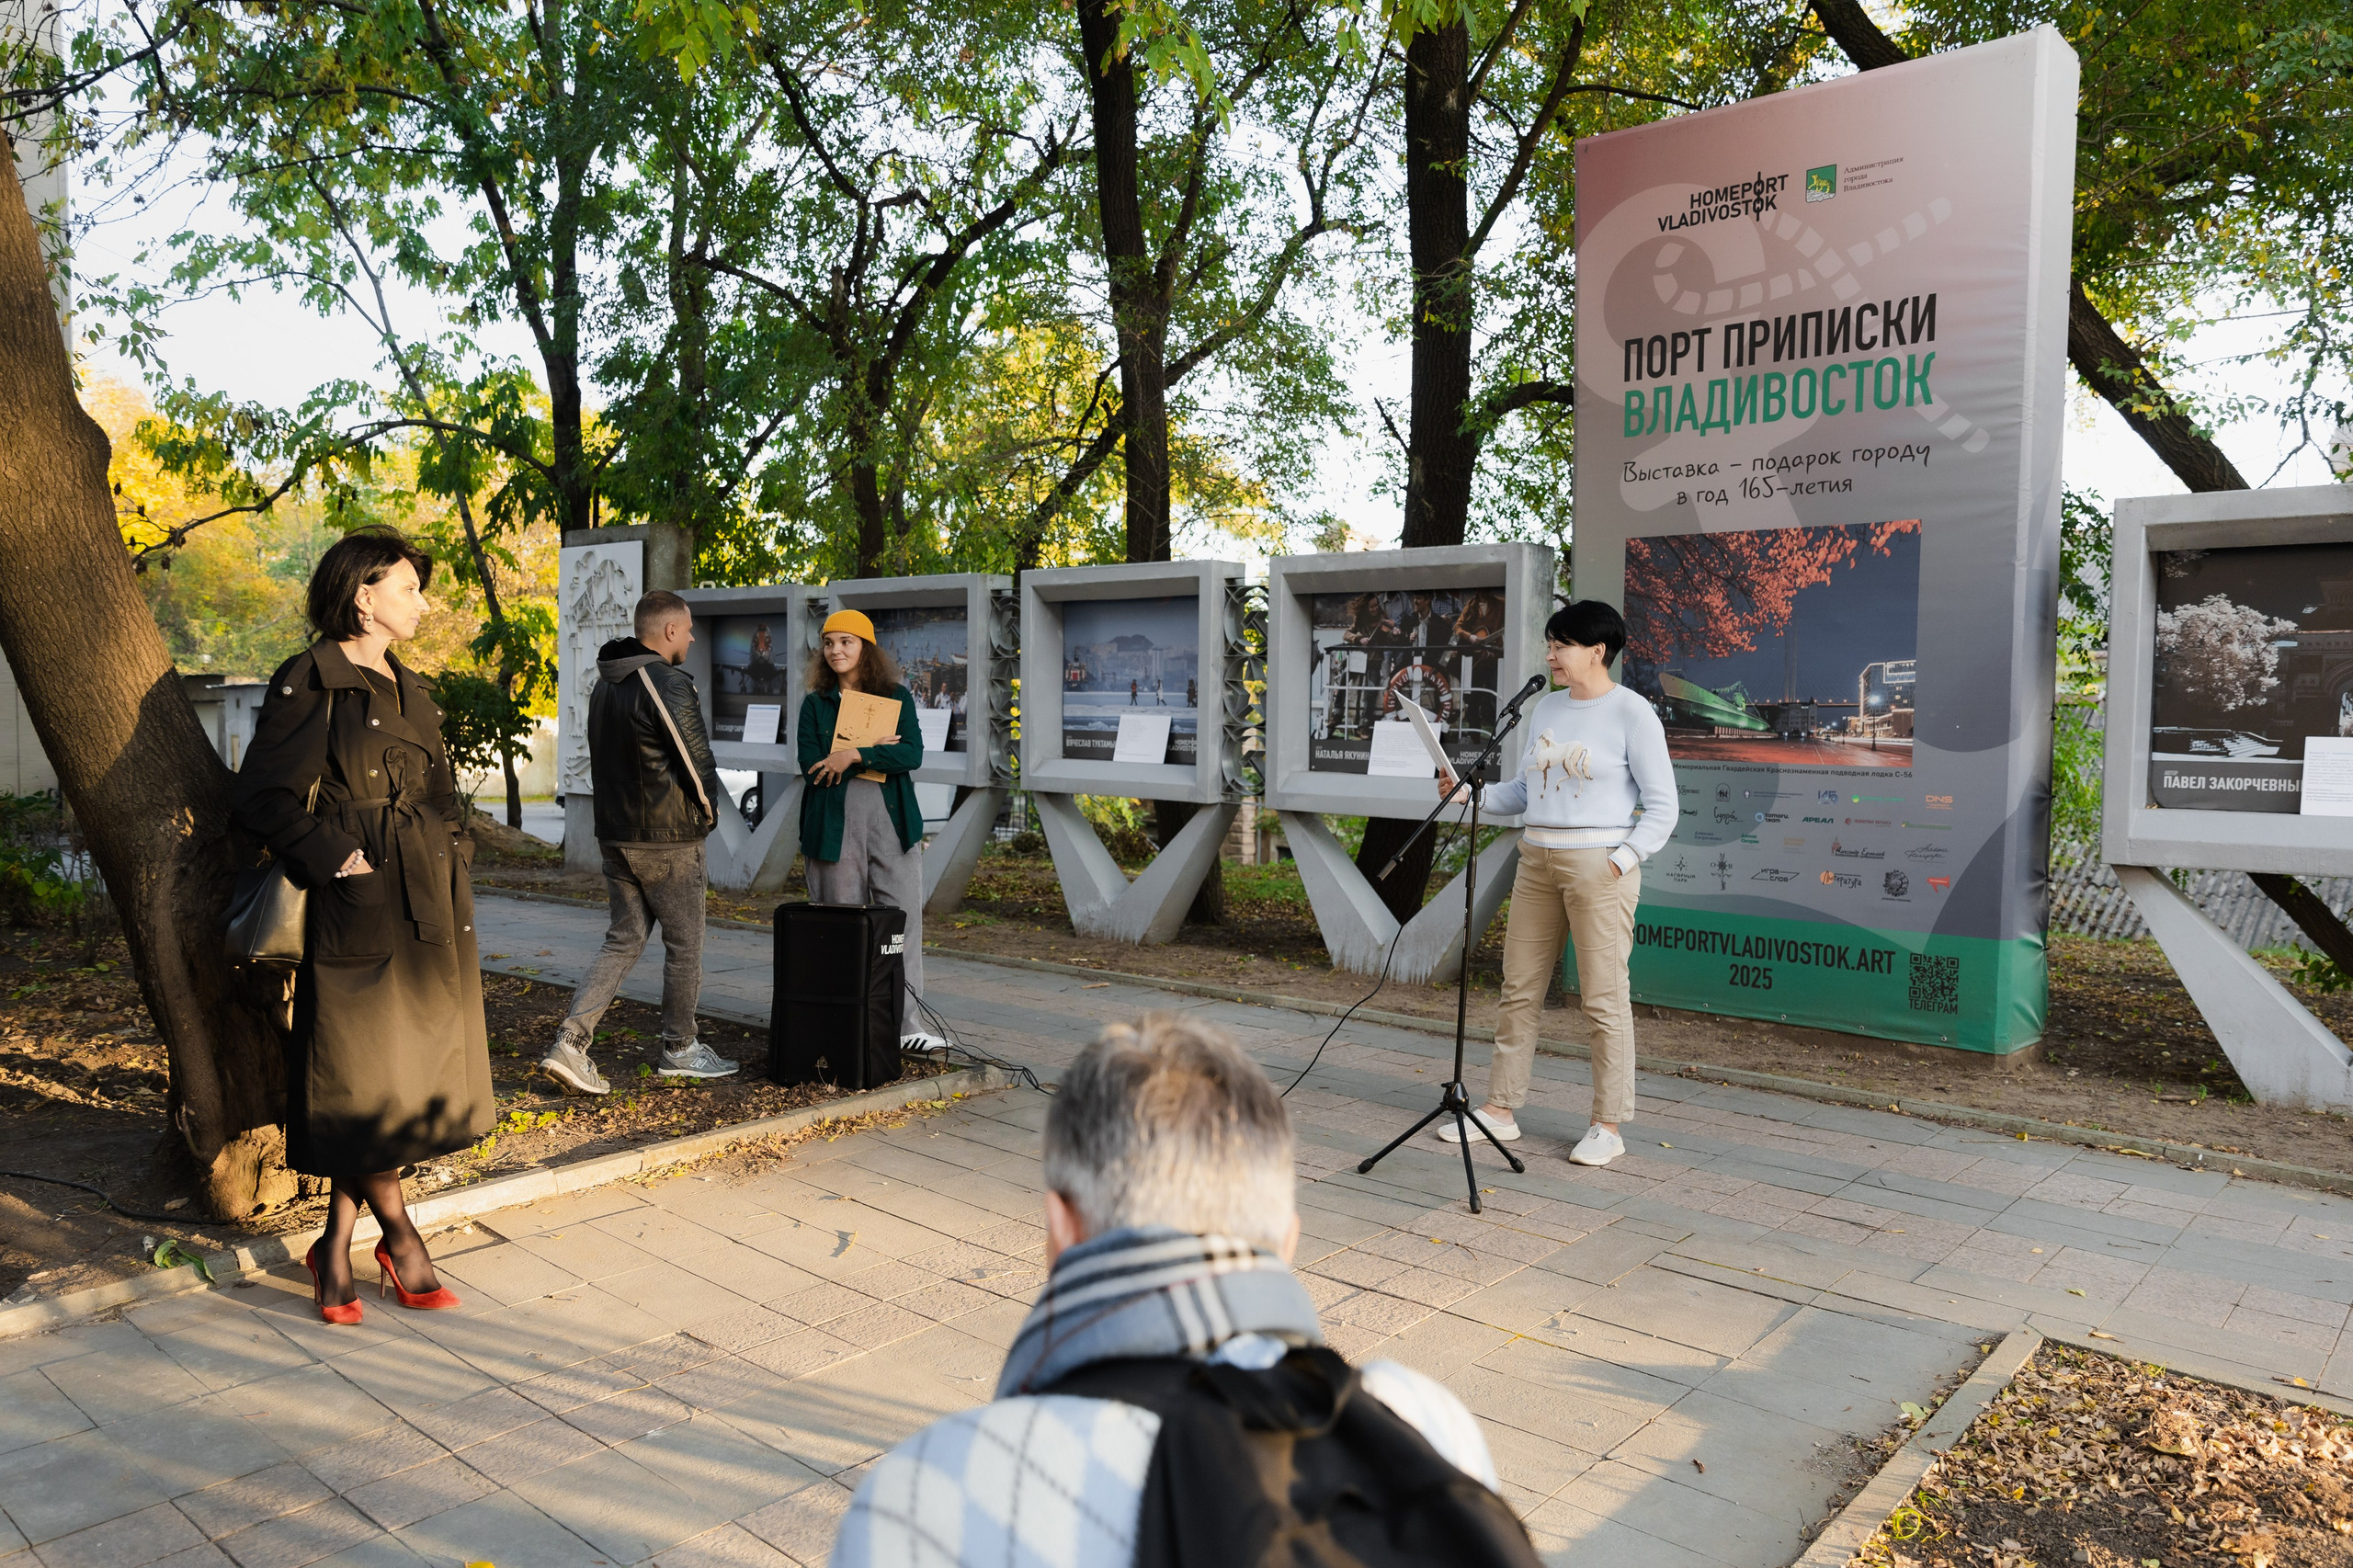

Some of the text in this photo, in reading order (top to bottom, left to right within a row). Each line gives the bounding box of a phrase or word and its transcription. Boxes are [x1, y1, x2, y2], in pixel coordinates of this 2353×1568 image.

[1690, 172, 1789, 209] HOMEPORT
[1844, 174, 1868, 183] города
[1658, 194, 1778, 232] VLADIVOSTOK
[1624, 293, 1937, 382] ПОРТ ПРИПИСКИ
[1623, 351, 1937, 438] ВЛАДИВОСТОК
[1622, 460, 1720, 483] Выставка
[1752, 450, 1842, 476] подарок
[1851, 444, 1931, 468] городу
[1696, 488, 1729, 506] год
[1738, 477, 1853, 500] 165-летия
[1315, 749, 1343, 760] НАТАЛЬЯ
[1673, 764, 1721, 772] Мемориальная
[1722, 765, 1765, 774] Гвардейская
[1766, 767, 1829, 776] Краснознаменная
[1831, 770, 1870, 778] подводная
[2163, 776, 2302, 792] ПАВЕЛ ЗАКОРЧЕВНЫ
[1926, 795, 1953, 803] DNS
[1729, 964, 1773, 990] 2025
[1909, 999, 1959, 1016] ТЕЛЕГРАМ
